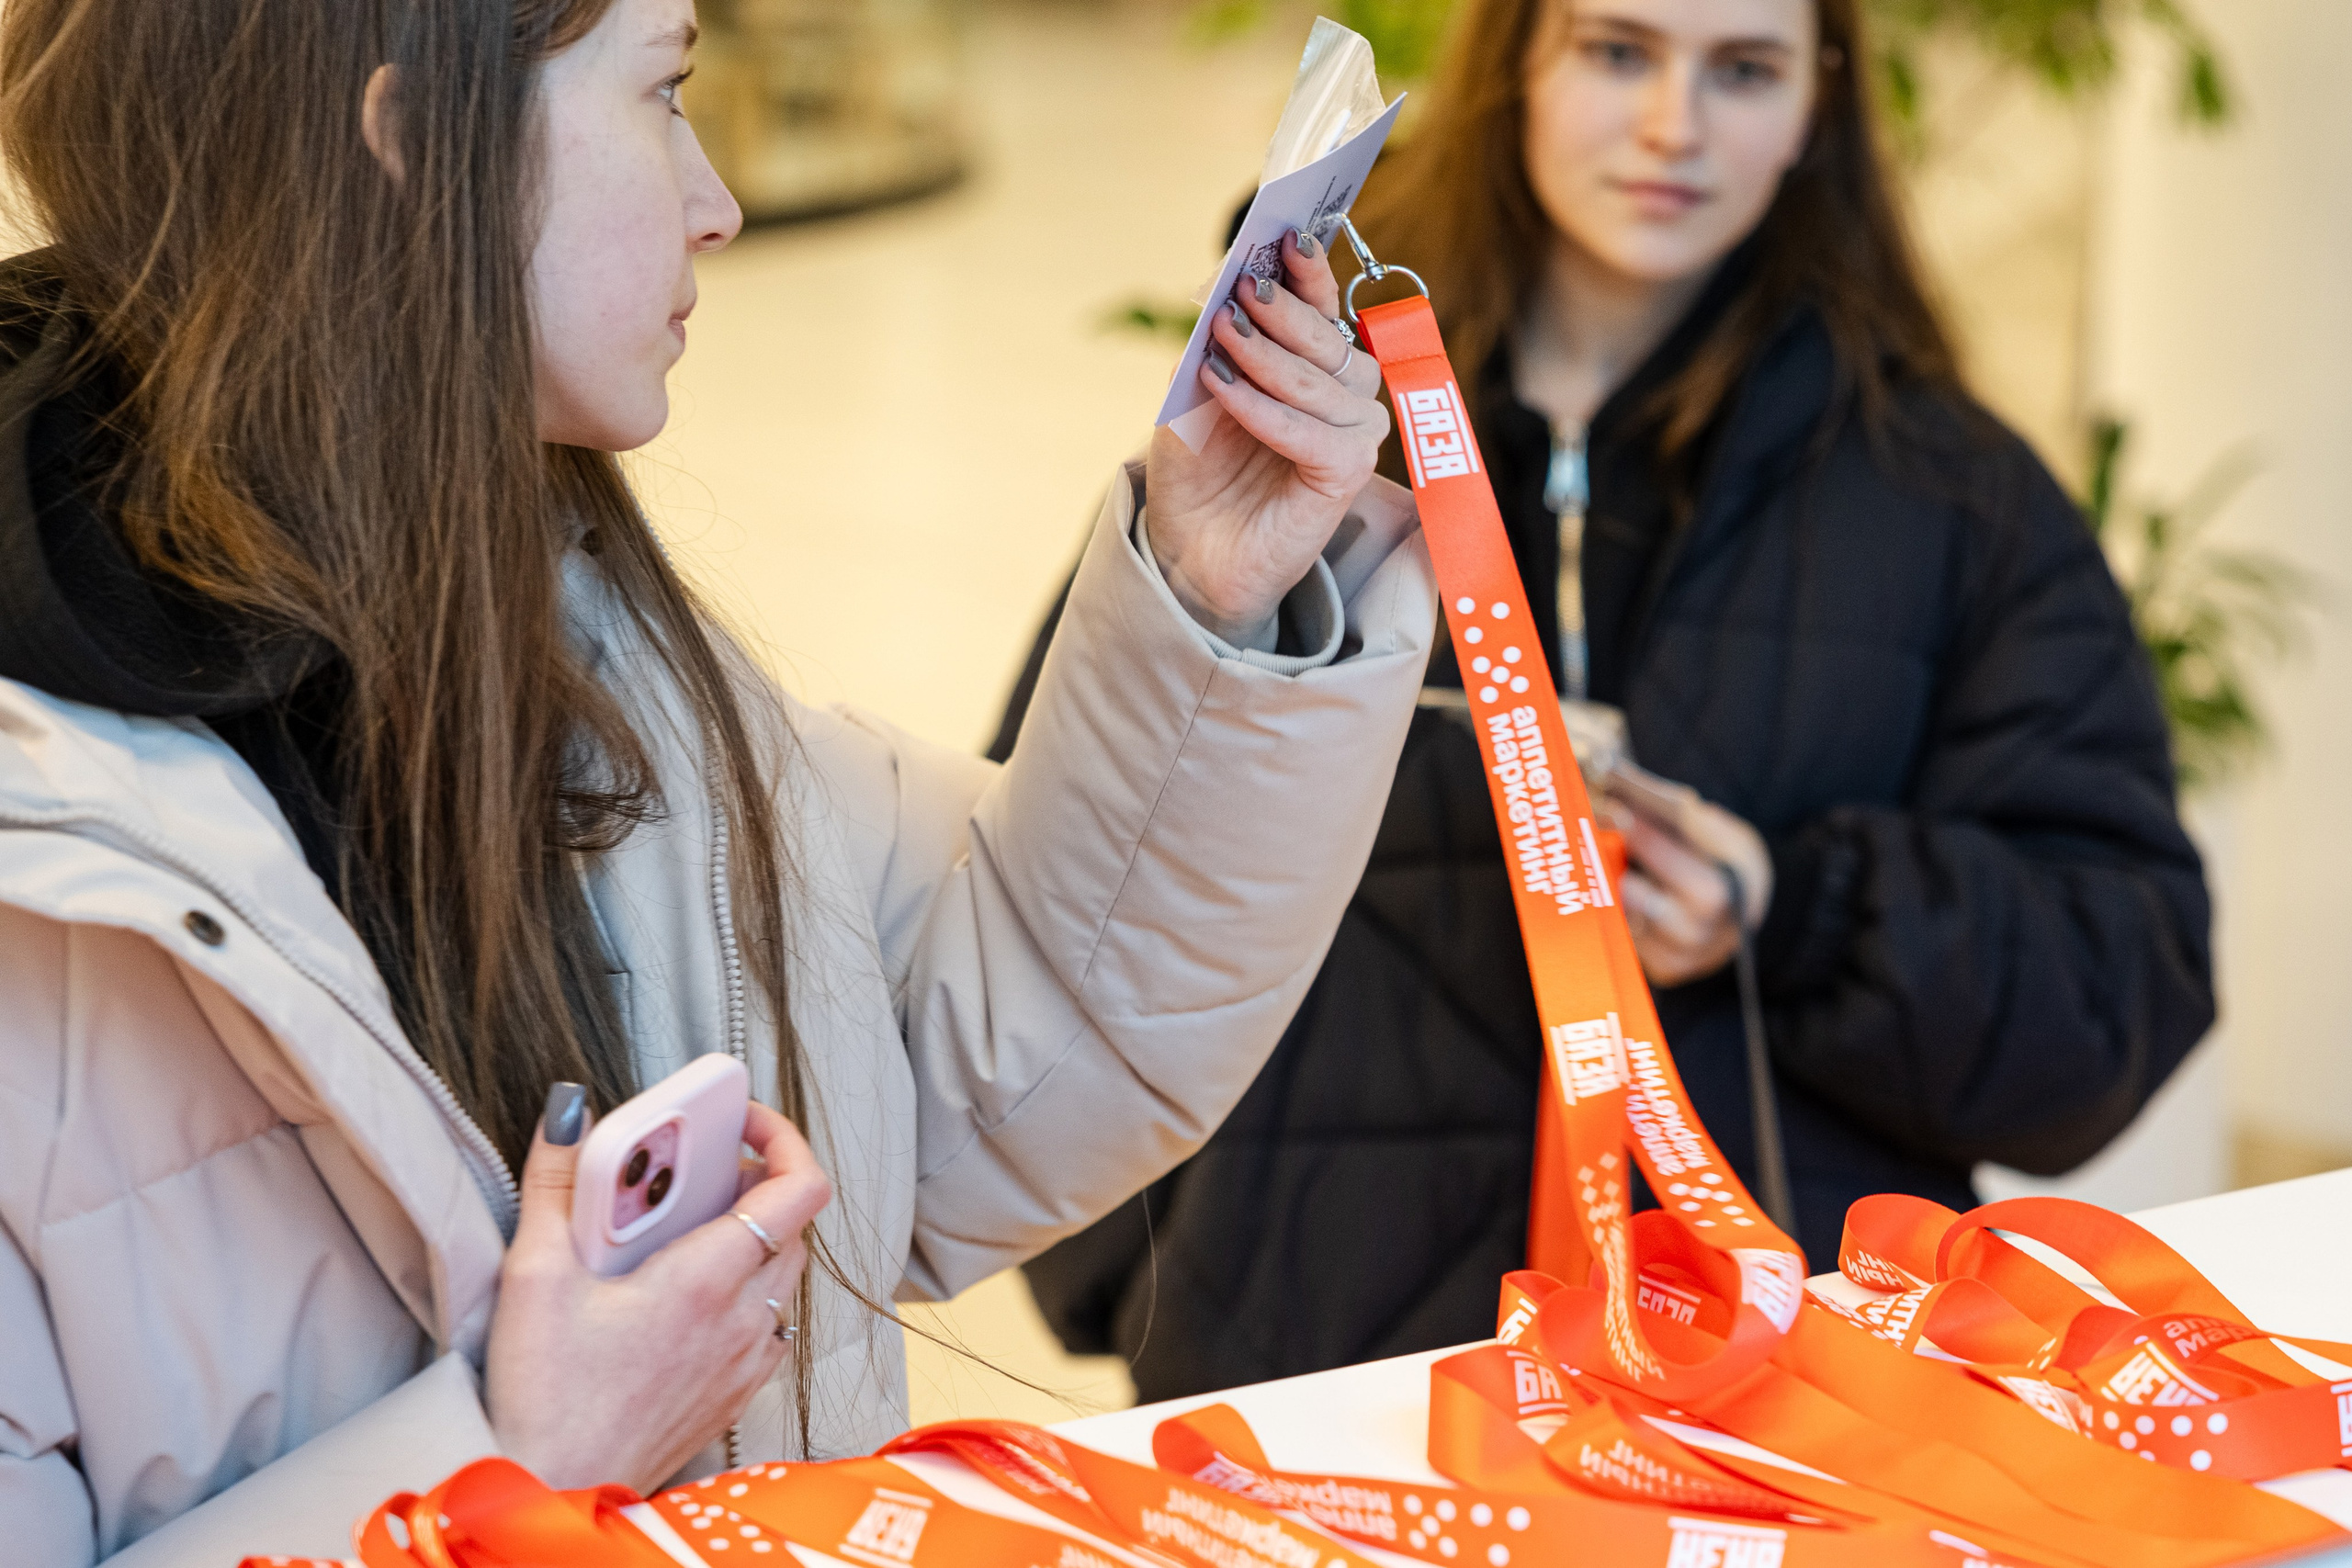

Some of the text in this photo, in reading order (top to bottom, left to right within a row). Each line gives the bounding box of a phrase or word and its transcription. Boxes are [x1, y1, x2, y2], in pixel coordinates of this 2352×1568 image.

[1406, 387, 1471, 482] БАЗА
[1486, 712, 1555, 896] маркетинг
[1510, 704, 1586, 916] аппетитный
[1560, 1016, 1622, 1100] БАЗА
